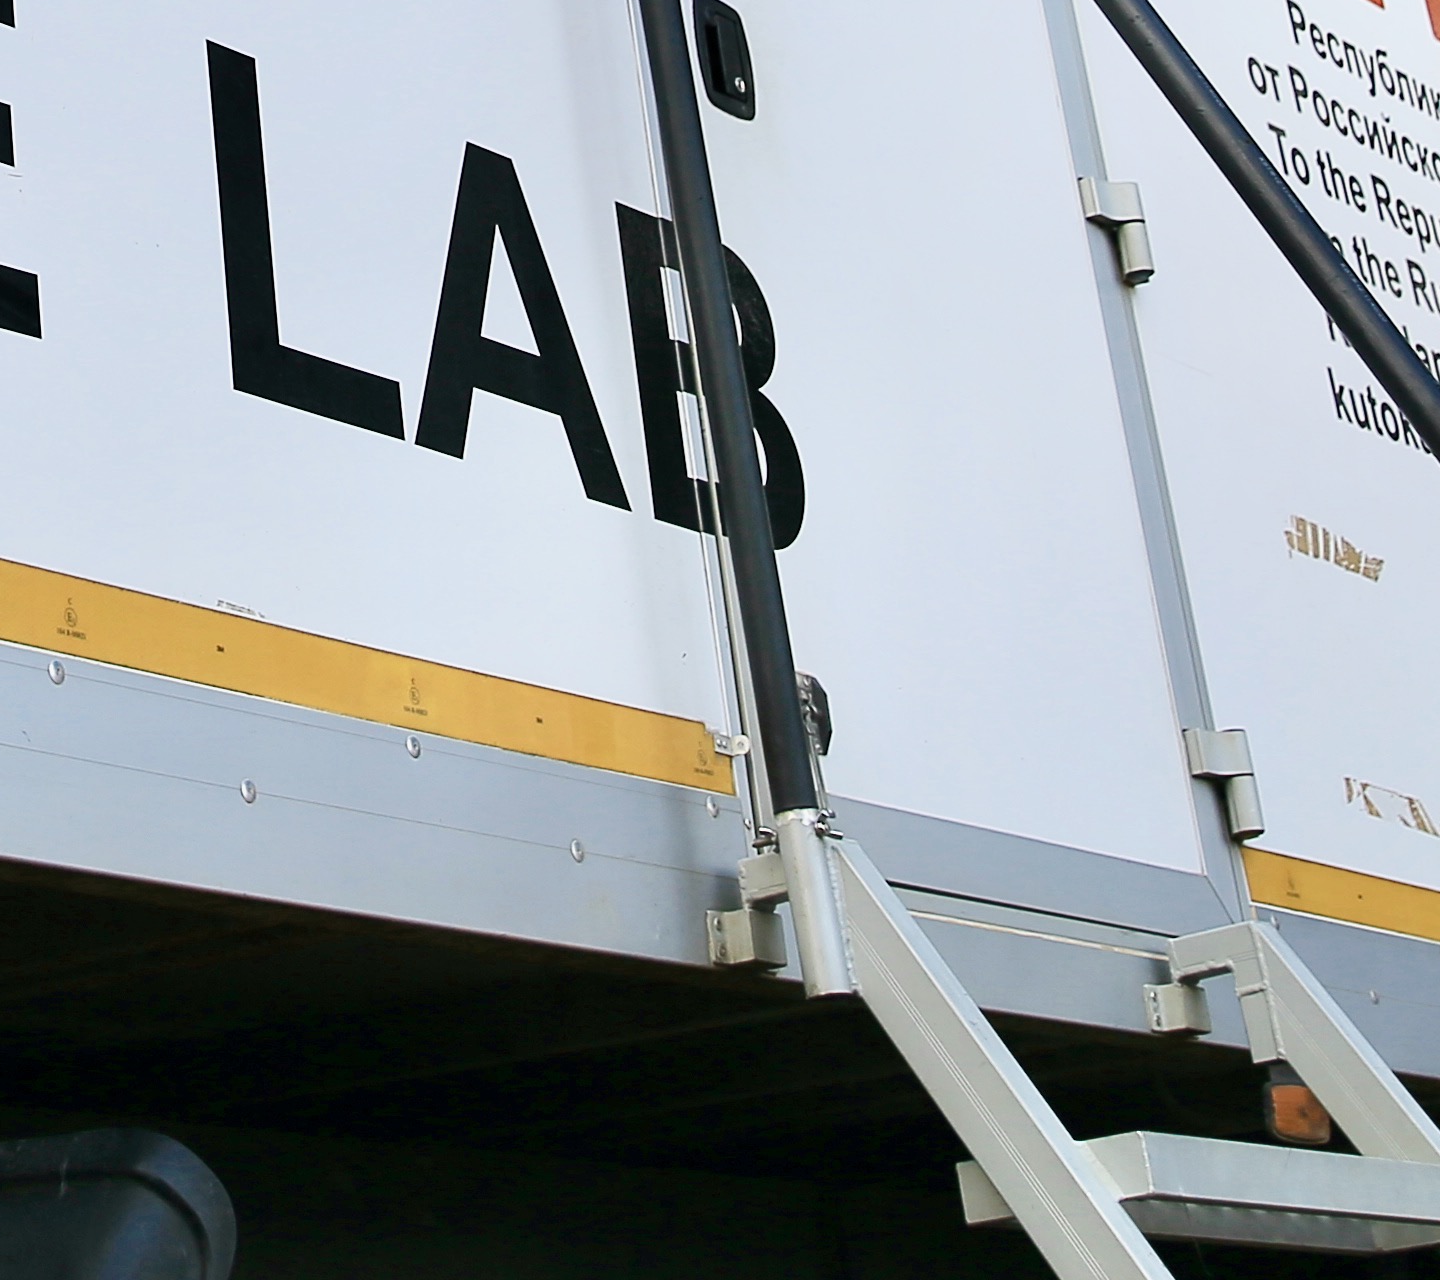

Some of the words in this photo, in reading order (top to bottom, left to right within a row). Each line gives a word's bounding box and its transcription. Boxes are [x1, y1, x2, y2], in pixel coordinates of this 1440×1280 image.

[1248, 57, 1280, 103] от
[1268, 123, 1311, 186] To
[1316, 150, 1367, 213] the
[205, 40, 806, 551] LAB
[1353, 235, 1403, 299] the
